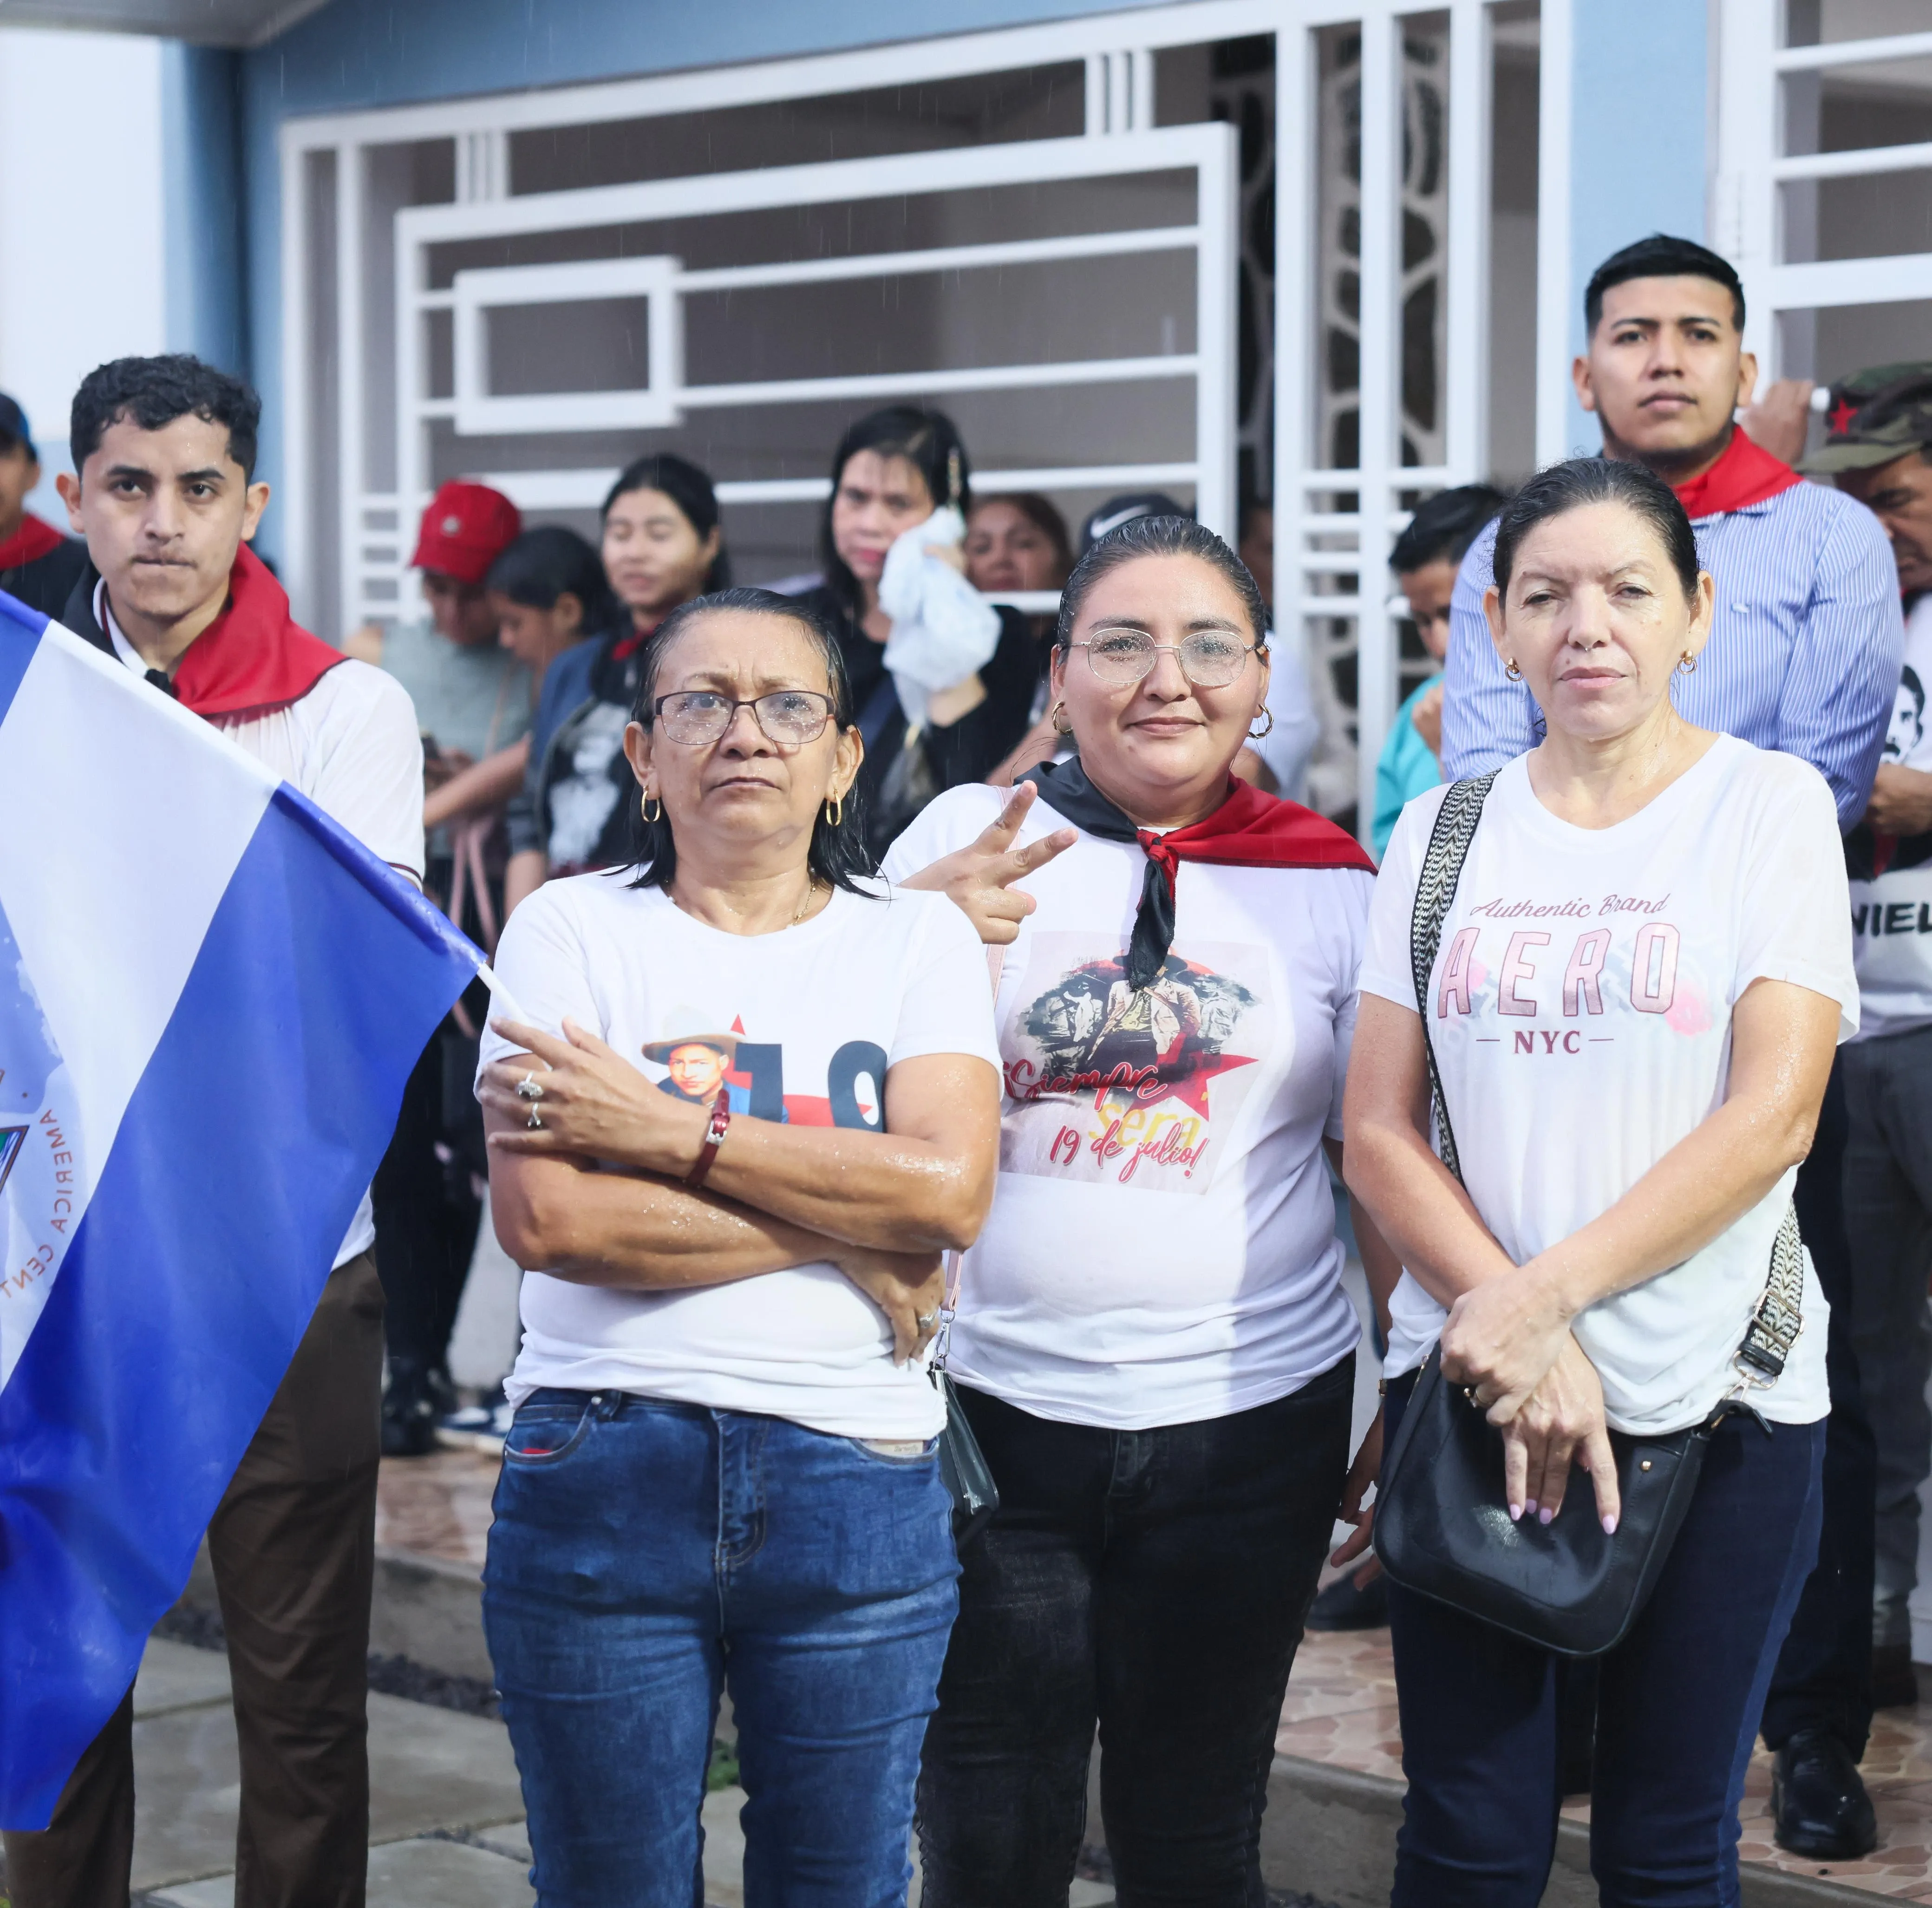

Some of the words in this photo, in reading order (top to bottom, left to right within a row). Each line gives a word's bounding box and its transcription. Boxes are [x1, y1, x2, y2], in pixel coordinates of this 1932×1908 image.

[1469, 897, 1591, 918] Authentic
[1598, 893, 1671, 916] Brand
[1438, 923, 1680, 1018] AERO
[1514, 1031, 1581, 1054] NYC
[1050, 1125, 1080, 1166] 19
[1090, 1118, 1124, 1169] de
[1118, 1121, 1210, 1183] julio!
